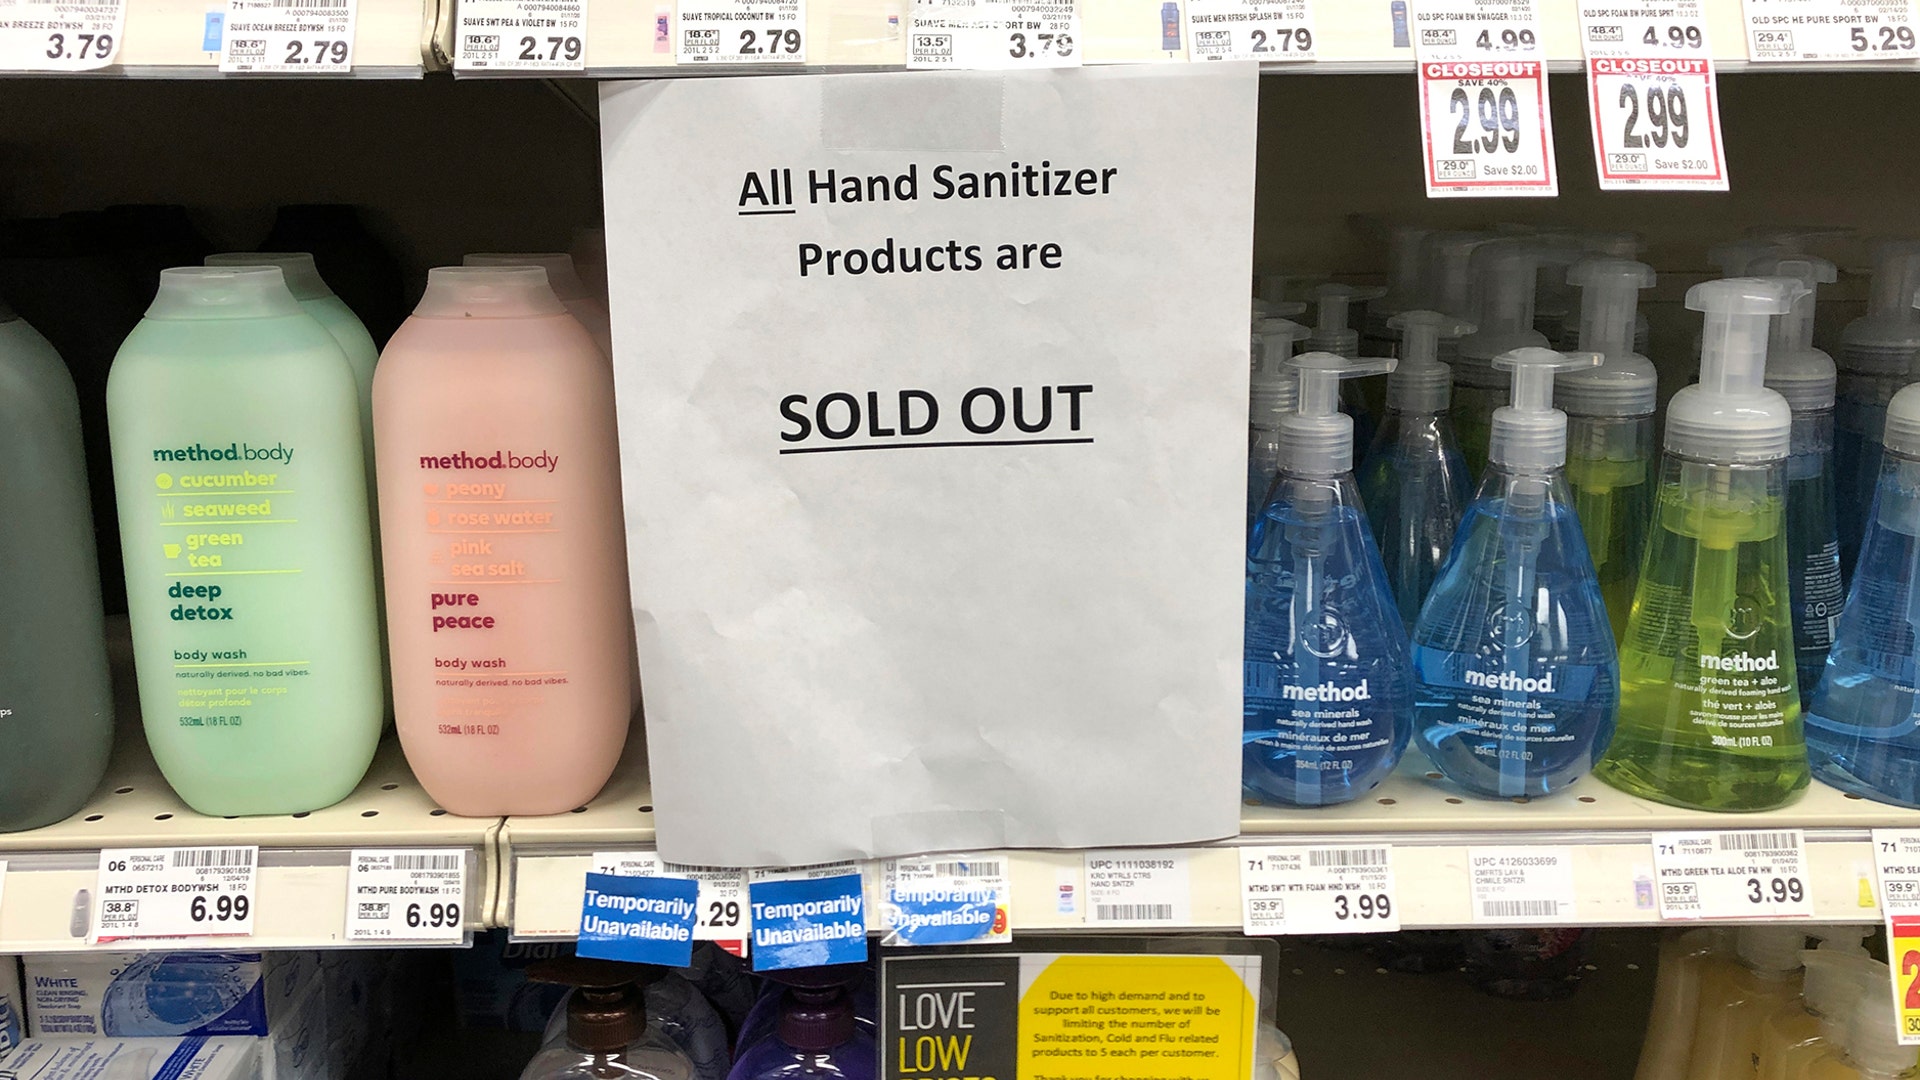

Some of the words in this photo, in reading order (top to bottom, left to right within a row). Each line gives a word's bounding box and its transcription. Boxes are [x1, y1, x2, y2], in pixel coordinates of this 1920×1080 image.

[463, 18, 485, 26] SUAVE
[486, 18, 499, 26] SWT
[502, 18, 514, 26] PEA
[522, 19, 544, 27] VIOLET
[683, 13, 702, 21] SUAVE
[704, 13, 733, 21] TROPICAL
[735, 13, 763, 21] COCONUT
[740, 29, 801, 54] 2.79
[1251, 28, 1312, 52] 2.79
[1476, 29, 1535, 51] 4.99
[1643, 26, 1701, 48] 4.99
[1851, 26, 1915, 51] 5.29
[46, 33, 113, 59] 3.79
[285, 40, 348, 64] 2.79
[519, 36, 582, 60] 2.79
[1010, 33, 1073, 58] 3.79
[1427, 63, 1536, 77] CLOSEOUT
[1596, 60, 1703, 72] CLOSEOUT
[1450, 87, 1520, 154] 2.99
[1619, 83, 1689, 148] 2.99
[1484, 165, 1508, 175] Save
[1512, 165, 1537, 175] $2.00
[1655, 160, 1679, 169] Save
[1682, 160, 1708, 169] $2.00
[739, 169, 795, 206] All
[809, 164, 918, 204] Hand
[933, 161, 1117, 199] Sanitizer
[799, 238, 982, 276] Products
[996, 241, 1062, 270] are
[779, 389, 939, 443] SOLD
[961, 384, 1093, 435] OUT
[180, 471, 278, 488] cucumber
[446, 483, 506, 499] peony
[183, 499, 271, 516] seaweed
[448, 513, 489, 525] rose
[494, 512, 553, 525] water
[186, 533, 243, 550] green
[451, 539, 492, 556] pink
[188, 554, 222, 567] tea
[451, 564, 484, 576] sea
[488, 560, 525, 575] salt
[168, 582, 221, 601] deep
[431, 593, 479, 610] pure
[170, 604, 233, 620] detox
[433, 616, 495, 632] peace
[174, 650, 208, 662] body
[212, 649, 247, 659] wash
[435, 658, 467, 670] body
[471, 658, 506, 667] wash
[176, 671, 214, 679] naturally
[1700, 676, 1730, 686] green
[1732, 677, 1749, 686] tea
[1760, 676, 1777, 685] aloe
[1674, 681, 1707, 694] naturally
[1709, 686, 1737, 696] derived
[1739, 688, 1766, 697] foaming
[1472, 695, 1490, 705] sea
[1494, 698, 1541, 709] minerals
[1292, 710, 1311, 718] sea
[1314, 708, 1359, 718] minerals
[1333, 733, 1347, 742] de
[1350, 732, 1370, 740] mer
[1659, 845, 1674, 854] 71
[1881, 843, 1896, 852] 71
[109, 861, 126, 871] 06
[1091, 861, 1112, 869] UPC
[1248, 861, 1263, 870] 71
[1474, 858, 1495, 866] UPC
[105, 885, 133, 893] MTHD
[136, 885, 168, 893] DETOX
[172, 884, 219, 892] BODYWSH
[1748, 877, 1803, 903] 3.99
[191, 895, 249, 922] 6.99
[586, 890, 694, 919] Temporarily
[752, 895, 861, 921] Temporarily
[1335, 894, 1390, 920] 3.99
[406, 903, 460, 927] 6.99
[584, 916, 689, 942] Unavailable
[756, 921, 862, 946] Unavailable
[35, 977, 78, 987] WHITE
[1050, 991, 1073, 1000] Due
[1077, 992, 1088, 1000] to
[1091, 991, 1115, 1001] high
[1118, 991, 1166, 1000] demand
[1169, 992, 1190, 1000] and
[1193, 993, 1205, 1001] to
[900, 992, 975, 1030] LOVE
[1034, 1006, 1079, 1016] support
[1082, 1006, 1094, 1014] all
[1097, 1007, 1161, 1016] customers,
[1183, 1006, 1202, 1015] will
[1206, 1007, 1220, 1016] be
[1063, 1019, 1104, 1030] limiting
[1109, 1020, 1127, 1028] the
[1131, 1019, 1175, 1028] number
[1178, 1020, 1190, 1028] of
[1034, 1034, 1103, 1044] Sanitization,
[1106, 1034, 1132, 1043] Cold
[1135, 1034, 1156, 1043] and
[1159, 1034, 1175, 1043] Flu
[1179, 1034, 1219, 1043] related
[900, 1035, 972, 1072] LOW
[1032, 1048, 1082, 1058] products
[1086, 1048, 1097, 1057] to
[1101, 1048, 1106, 1057] 5
[1110, 1048, 1137, 1057] each
[1140, 1050, 1158, 1058] per
[1161, 1049, 1219, 1058] customer.
